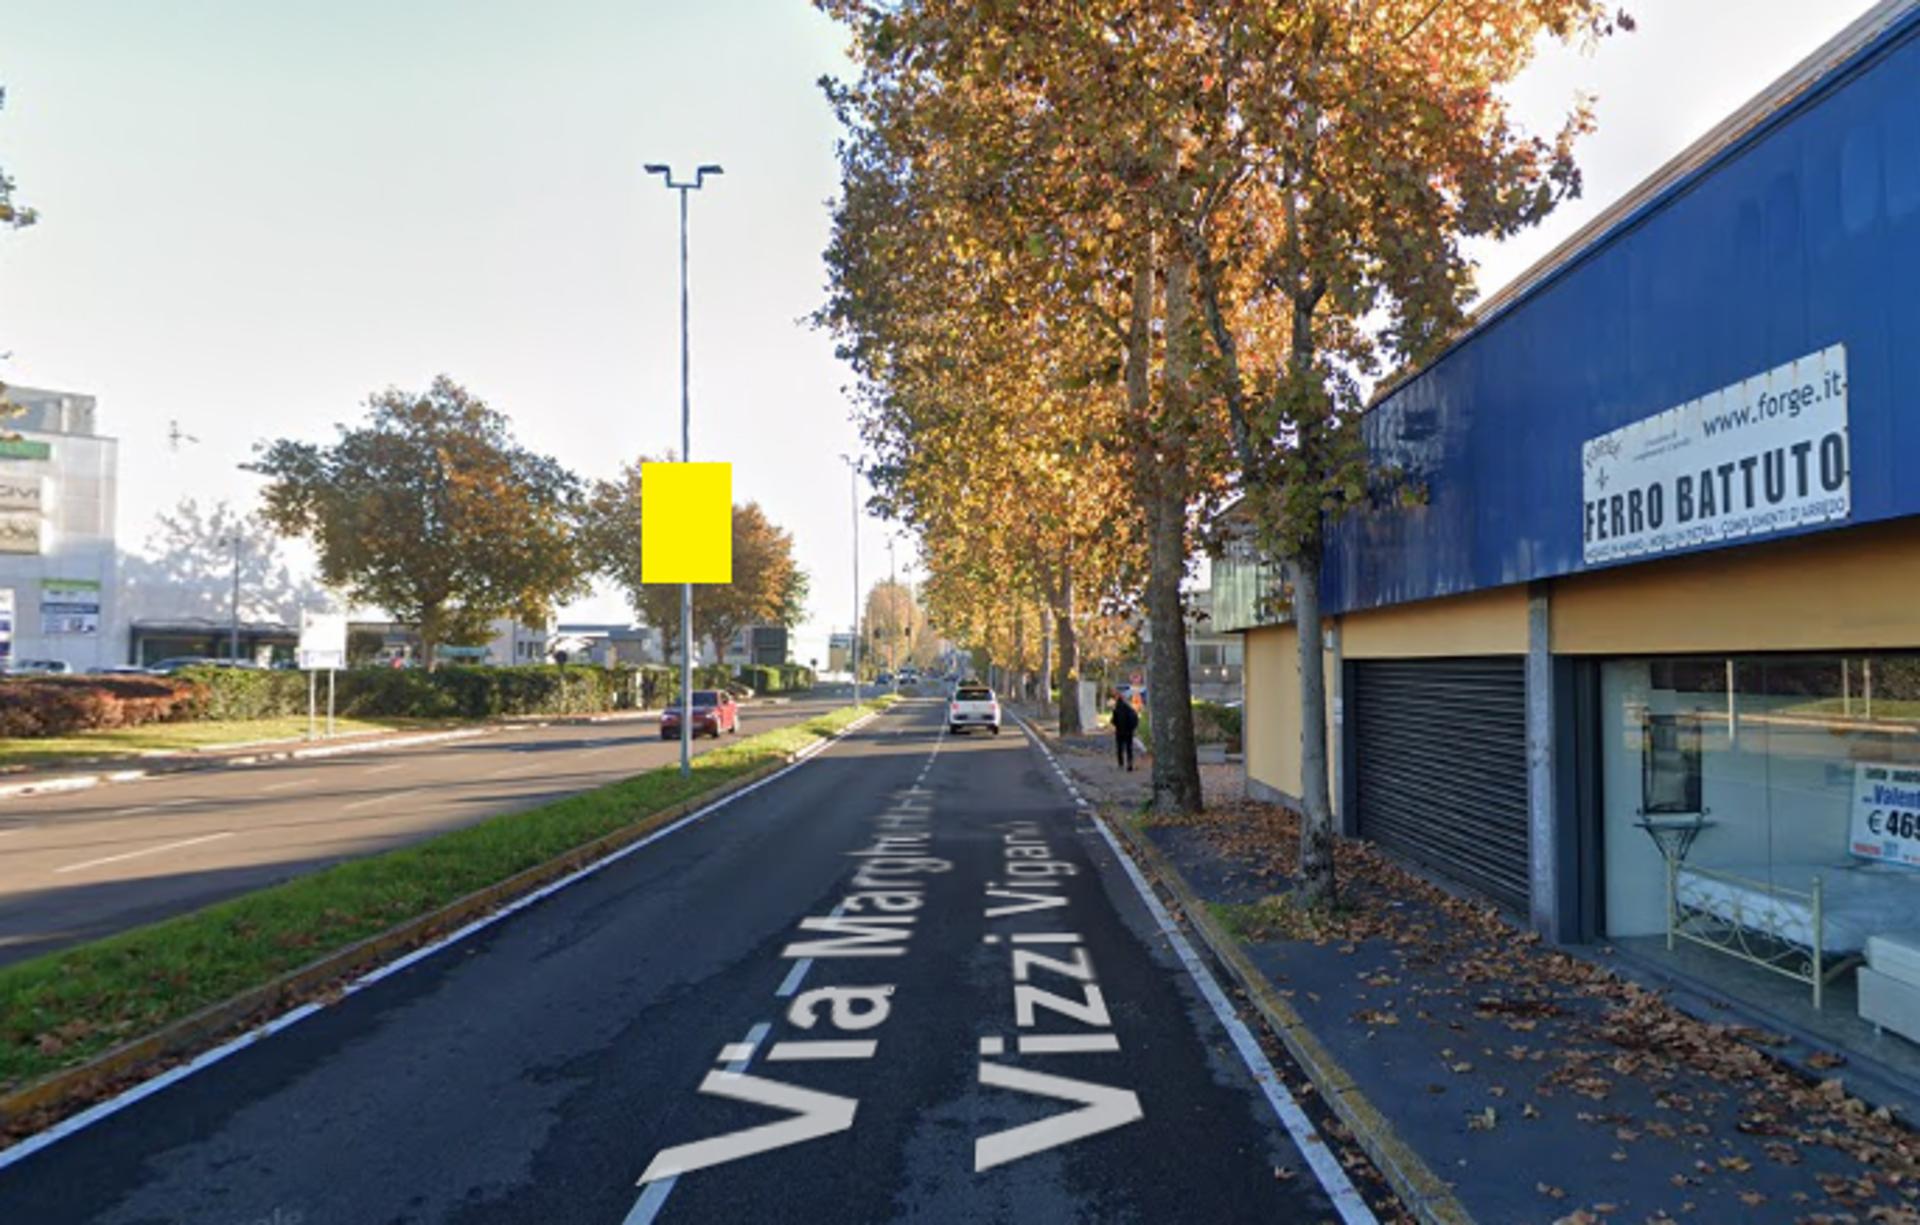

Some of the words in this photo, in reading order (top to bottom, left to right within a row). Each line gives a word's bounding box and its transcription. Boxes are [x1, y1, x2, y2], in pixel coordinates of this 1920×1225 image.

[1702, 370, 1842, 437] www.forge.it
[1585, 482, 1664, 542] FERRO
[1676, 432, 1846, 524] BATTUTO
[1868, 809, 1883, 835] €
